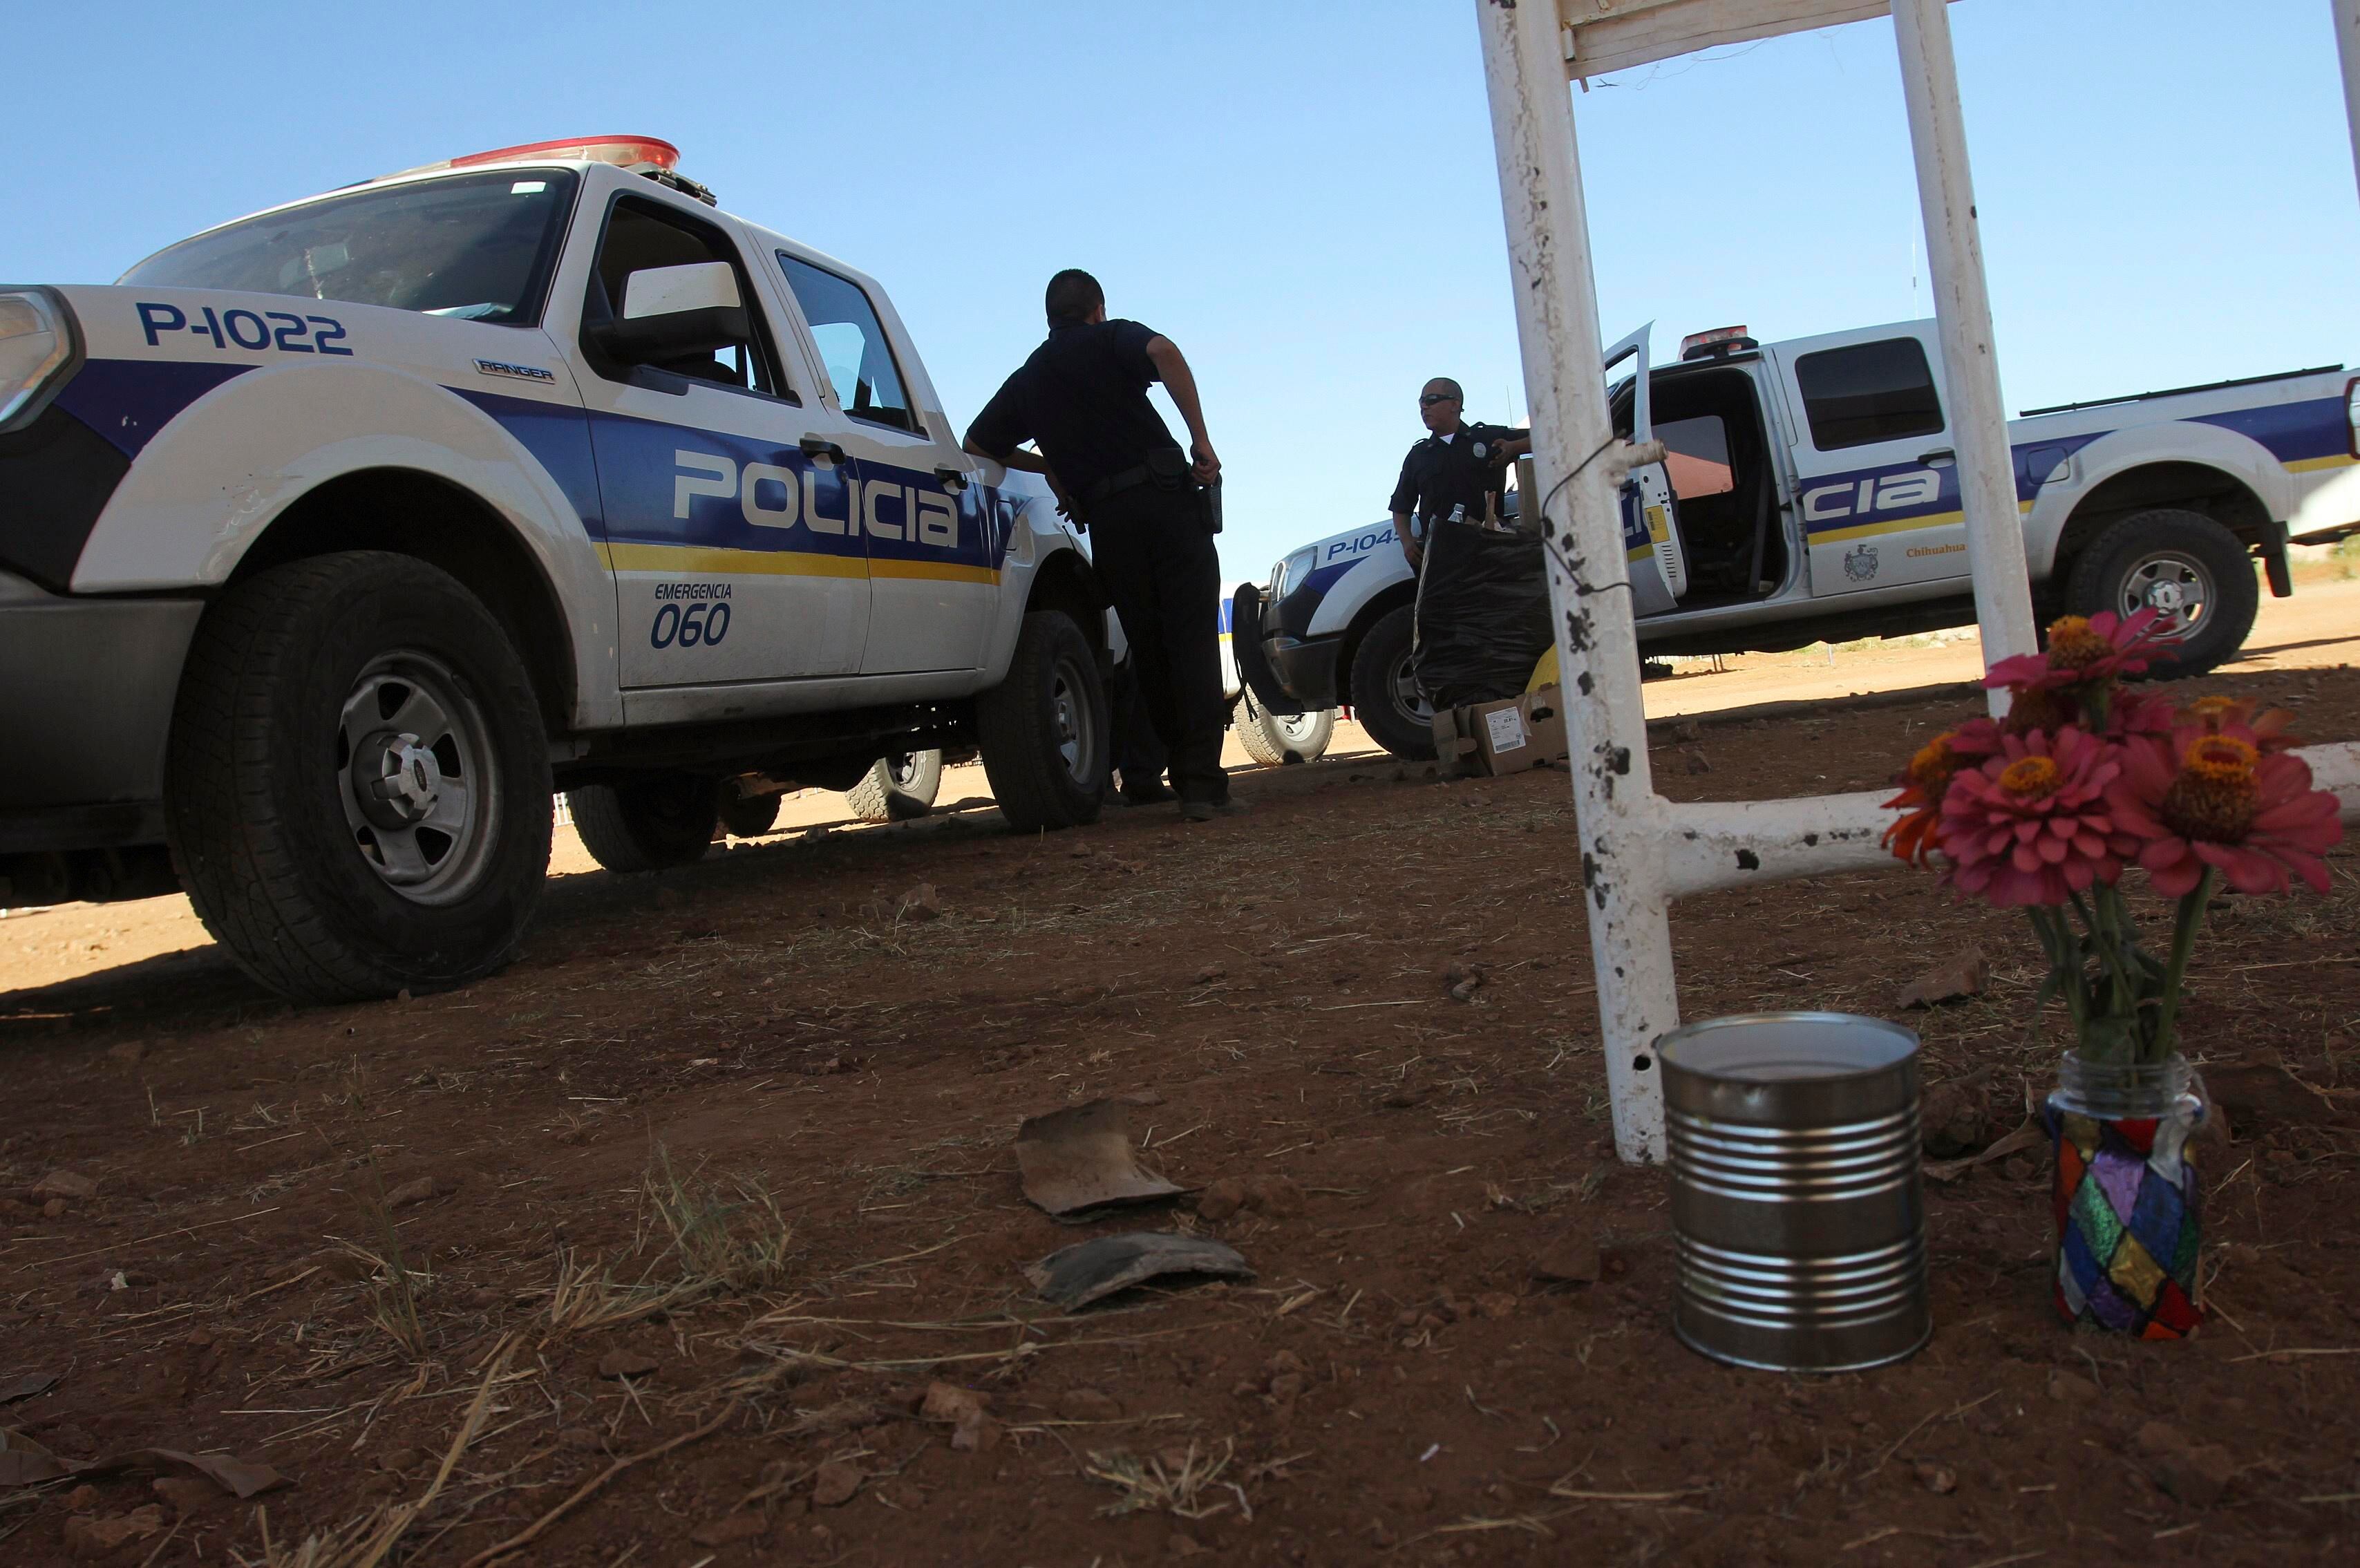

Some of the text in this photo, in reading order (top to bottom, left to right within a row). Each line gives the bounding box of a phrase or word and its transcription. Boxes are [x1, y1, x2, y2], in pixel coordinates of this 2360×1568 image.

[136, 302, 355, 355] P-1022
[478, 359, 555, 380] RANGER
[1906, 543, 1966, 558] Chihuahua
[654, 583, 732, 600] EMERGENCIA
[651, 602, 730, 649] 060
